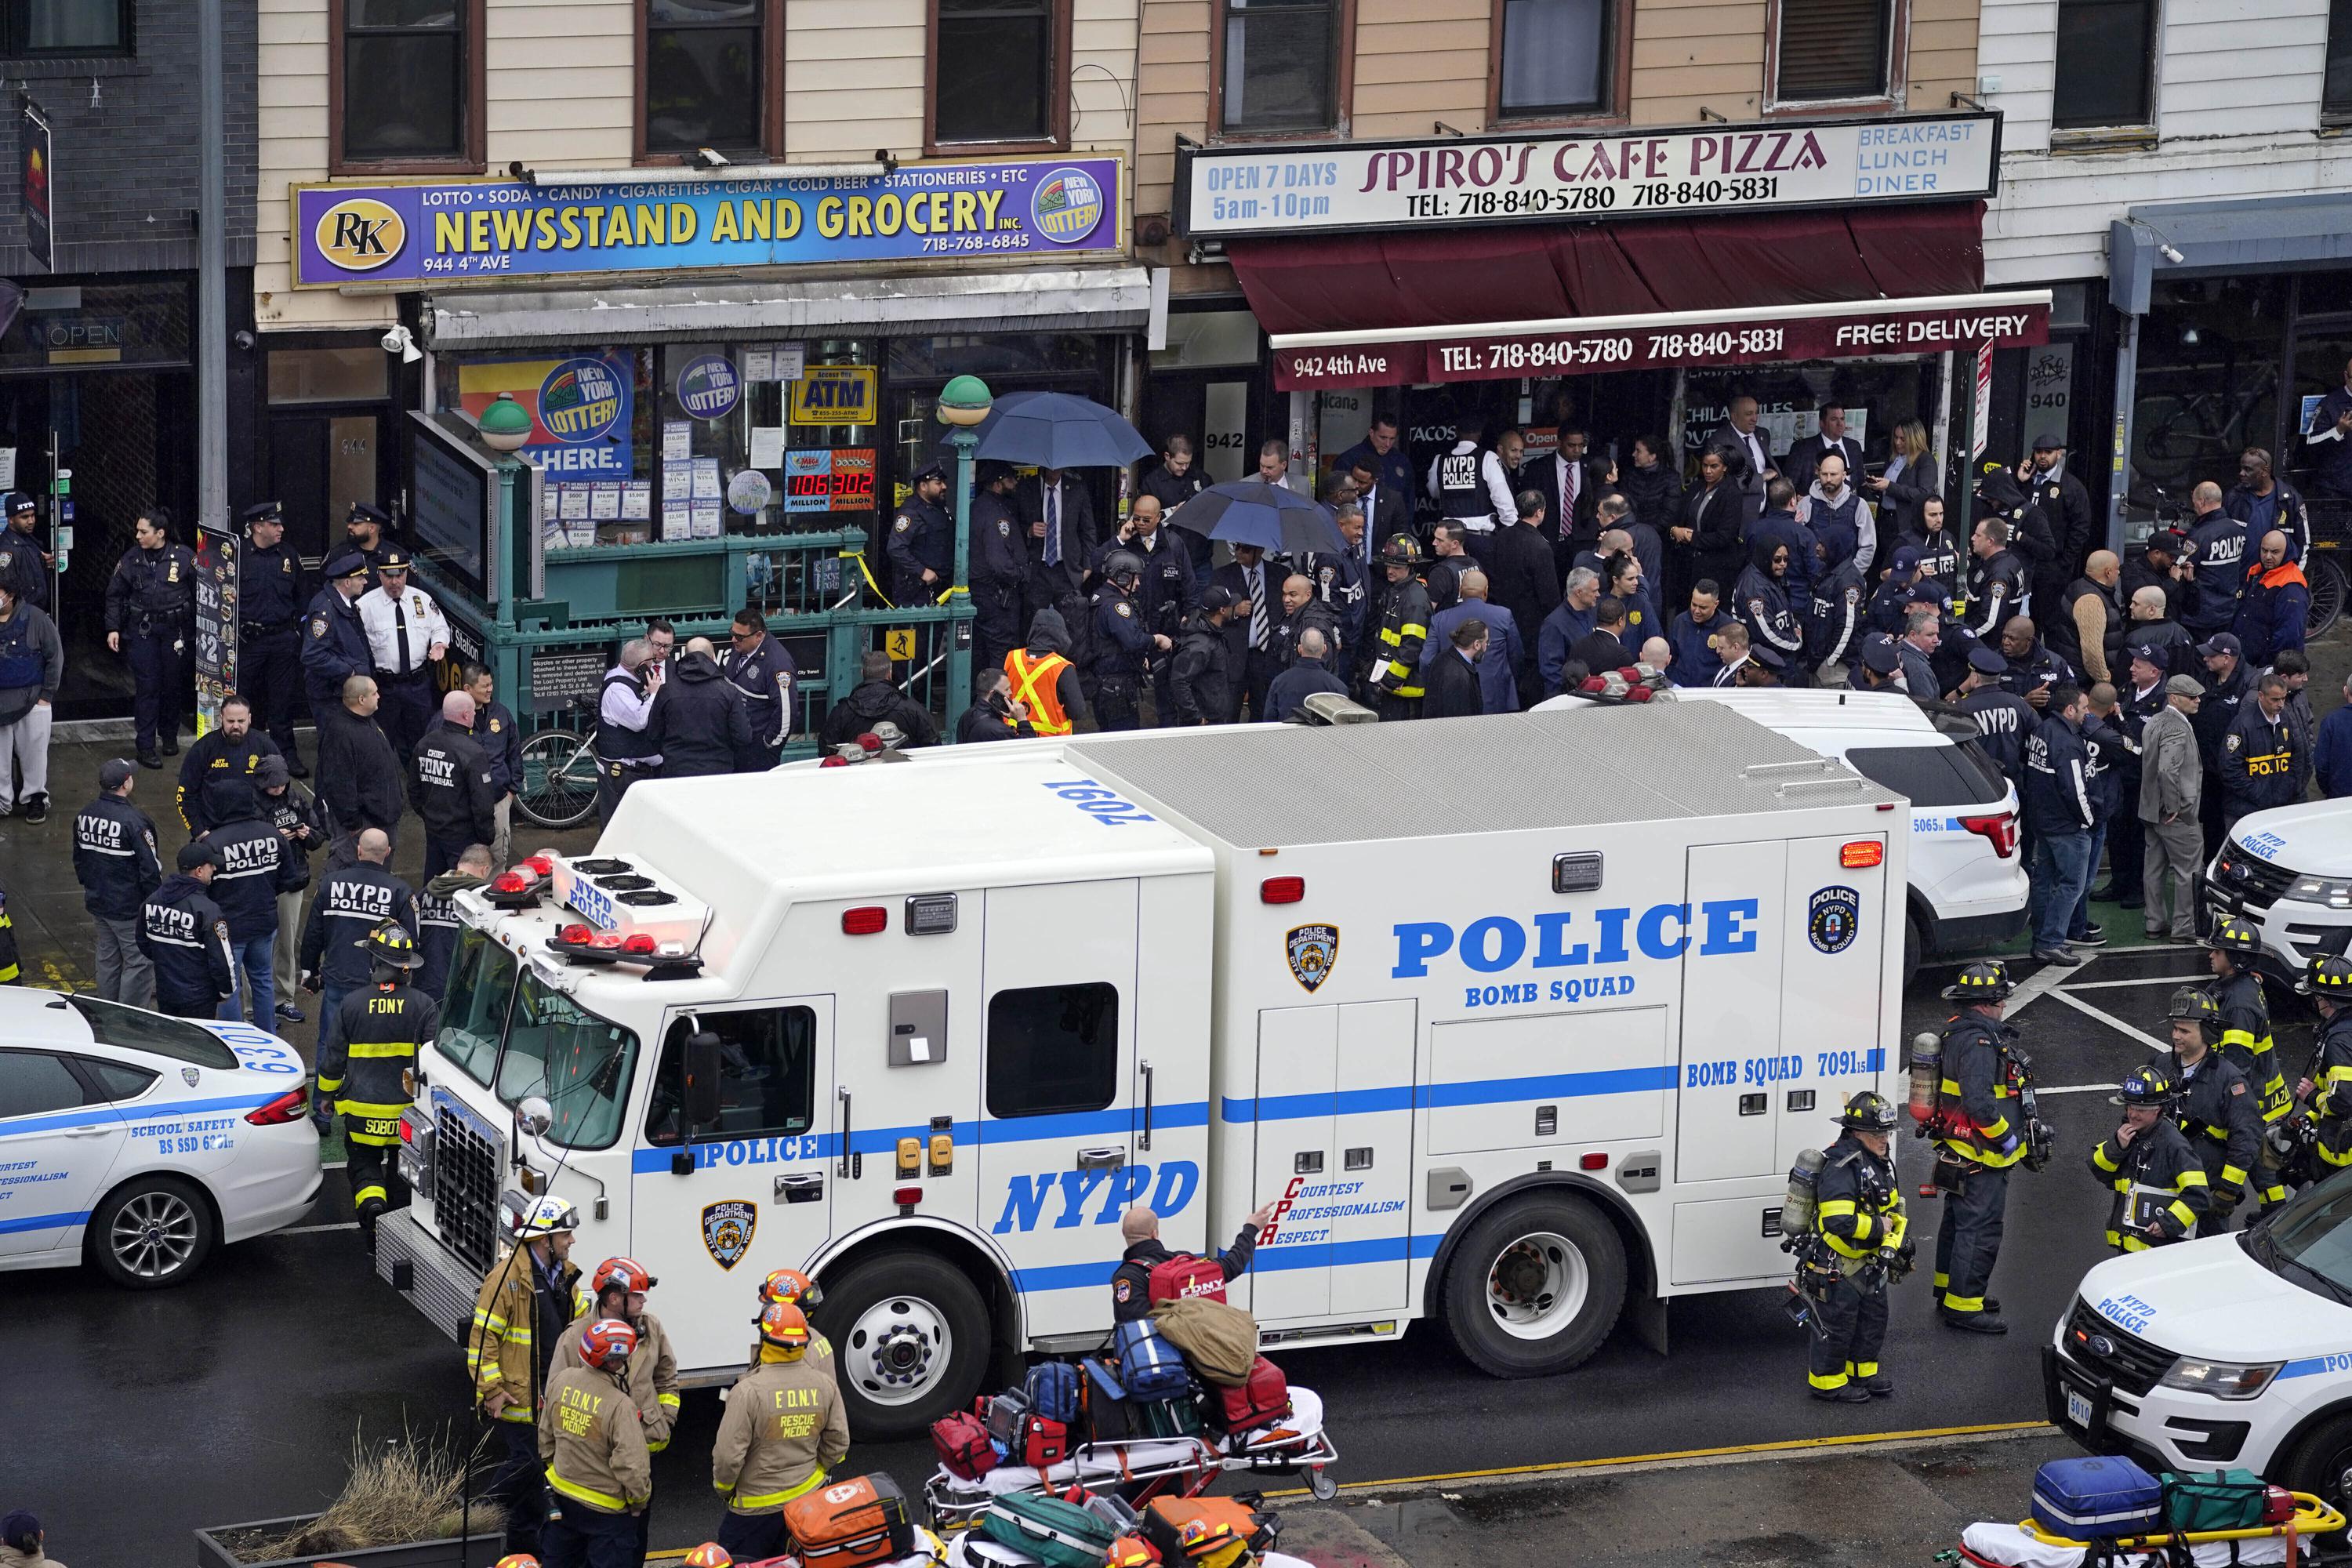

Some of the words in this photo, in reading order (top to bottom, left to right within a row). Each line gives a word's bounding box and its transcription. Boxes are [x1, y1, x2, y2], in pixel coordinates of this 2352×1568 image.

[1860, 123, 1975, 146] BREAKFAST
[1359, 145, 1537, 193] SPIRO'S
[1553, 139, 1670, 182] CAFE
[1690, 130, 1828, 176] PIZZA
[1860, 149, 1947, 170] LUNCH
[423, 192, 472, 205] LOTTO
[488, 190, 532, 203] SODA
[549, 187, 602, 201] CANDY
[619, 183, 710, 198] CIGARETTES
[725, 180, 771, 194] CIGAR
[788, 178, 828, 191] COLD
[833, 176, 868, 190] BEER
[884, 171, 986, 187] STATIONERIES
[1001, 169, 1027, 183] ETC
[1065, 176, 1088, 189] NEW
[1208, 166, 1260, 191] OPEN
[1267, 165, 1279, 187] 7
[1285, 162, 1337, 187] DAYS
[1858, 173, 1937, 194] DINER
[1067, 189, 1094, 206] YORK
[1214, 194, 1330, 220] 5am-10pm
[1407, 195, 1449, 217] TEL:
[1458, 186, 1615, 216] 718-840-5780
[1632, 176, 1777, 207] 718-840-5831
[435, 203, 696, 253] NEWSSTAND
[710, 199, 801, 242] AND
[816, 190, 1004, 238] GROCERY
[1000, 217, 1022, 230] INC.
[1040, 203, 1098, 234] LOTTERY
[329, 212, 390, 256] RK
[923, 234, 1029, 252] 718-768-6845
[424, 259, 452, 271] 944
[459, 256, 478, 270] 4TH
[480, 256, 510, 270] AVE
[50, 325, 120, 345] OPEN
[1836, 321, 1900, 347] FREE
[1908, 315, 2029, 343] DELIVERY
[1441, 347, 1483, 372] TEL:
[1490, 338, 1632, 368] 718-840-5780
[1648, 328, 1784, 360] 718-840-5831
[577, 368, 605, 383] NEW
[707, 363, 727, 374] NEW
[1294, 357, 1324, 378] 942
[1327, 355, 1352, 376] 4th
[1356, 354, 1387, 375] Ave
[579, 380, 614, 401] YORK
[709, 372, 733, 388] YORK
[685, 386, 736, 410] LOTTERY
[802, 379, 866, 408] ATM
[2031, 393, 2066, 408] 940
[547, 397, 618, 434] LOTTERY
[342, 439, 366, 455] 944
[1207, 433, 1243, 448] 942
[1526, 433, 1558, 445] Open
[543, 447, 622, 471] HERE.
[1443, 456, 1475, 472] NYPD
[795, 474, 828, 495] 106
[833, 473, 873, 494] 302
[1443, 472, 1475, 485] POLICE
[201, 633, 218, 663] $2
[455, 630, 479, 662] Station
[427, 749, 445, 759] CHIEF
[419, 757, 455, 778] FDNY
[1041, 779, 1156, 826] 7091
[78, 815, 121, 837] NYPD
[276, 815, 290, 827] ATF
[1913, 817, 1939, 833] 5065
[78, 831, 121, 848] POLICE
[223, 837, 278, 862] NYPD
[2240, 835, 2278, 860] POLICE
[2256, 832, 2287, 847] NYPD
[226, 854, 278, 872] POLICE
[331, 881, 392, 904] NYPD
[575, 877, 612, 914] NYPD
[1813, 889, 1857, 909] POLICE
[146, 904, 194, 930] NYPD
[331, 898, 390, 916] POLICE
[1822, 905, 1846, 916] NYPD
[1290, 934, 1336, 949] DEPARTMENT
[1299, 927, 1327, 937] POLICE
[1392, 898, 1759, 979] POLICE
[1811, 932, 1829, 951] BOMB
[1831, 930, 1854, 952] SQUAD
[1290, 956, 1300, 972] CITY
[1298, 973, 1306, 982] OF
[1316, 969, 1327, 984] NEW
[1326, 948, 1336, 967] YORK
[1465, 983, 1537, 1007] BOMB
[1550, 975, 1635, 1004] SQUAD
[369, 998, 405, 1014] FDNY
[205, 1025, 298, 1073] 6301
[1687, 1061, 1737, 1087] BOMB
[1744, 1055, 1802, 1086] SQUAD
[132, 1123, 183, 1138] SCHOOL
[188, 1118, 236, 1133] SAFETY
[468, 1114, 492, 1142] SQUAD
[159, 1140, 173, 1154] BS
[178, 1138, 198, 1153] SSD
[706, 1135, 817, 1168] POLICE
[993, 1160, 1200, 1235] NYPD
[1283, 1177, 1364, 1200] COURTESY
[705, 1210, 754, 1225] DEPARTMENT
[715, 1203, 745, 1213] POLICE
[1272, 1200, 1406, 1222] PROFESSIONALISM
[706, 1232, 716, 1250] CITY
[713, 1250, 723, 1261] OF
[732, 1247, 744, 1262] NEW
[743, 1225, 753, 1244] YORK
[1258, 1223, 1330, 1247] RESPECT
[1181, 1278, 1223, 1296] FDNY
[2097, 1298, 2149, 1334] POLICE
[2118, 1294, 2157, 1317] NYPD
[2092, 1338, 2105, 1352] Ford
[560, 1406, 593, 1426] RESCUE
[780, 1414, 816, 1427] RESCUE
[2071, 1400, 2089, 1422] 5010
[562, 1419, 586, 1436] MEDIC
[783, 1425, 810, 1439] MEDIC
